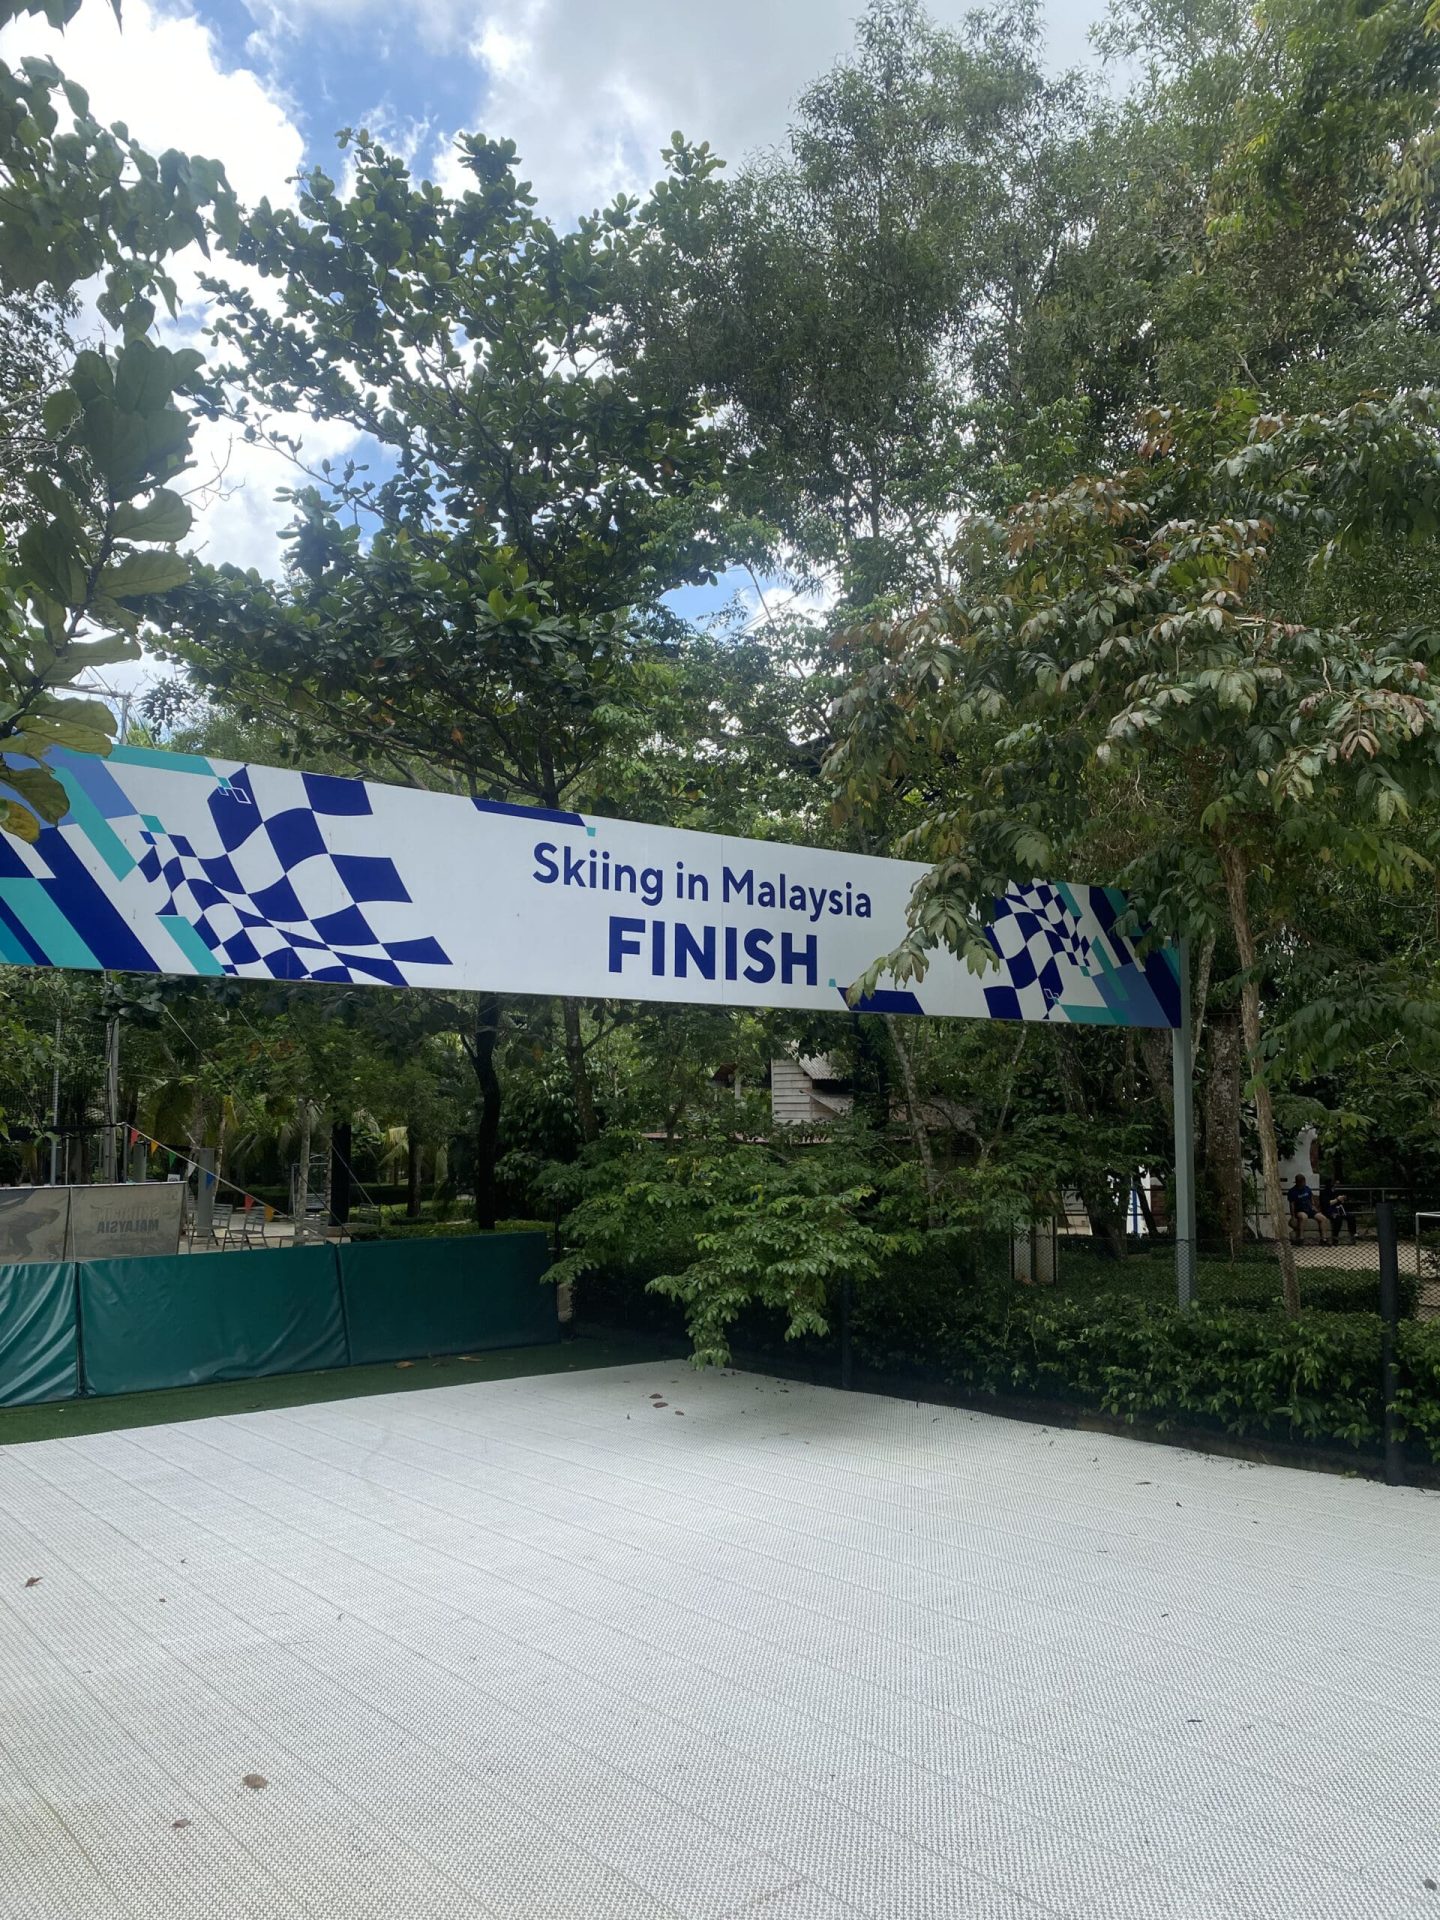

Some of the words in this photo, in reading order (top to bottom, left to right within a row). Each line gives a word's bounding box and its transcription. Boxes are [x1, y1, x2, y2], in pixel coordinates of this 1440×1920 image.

[532, 842, 663, 907] Skiing
[676, 861, 709, 902] in
[722, 866, 872, 922] Malaysia
[608, 916, 818, 986] FINISH
